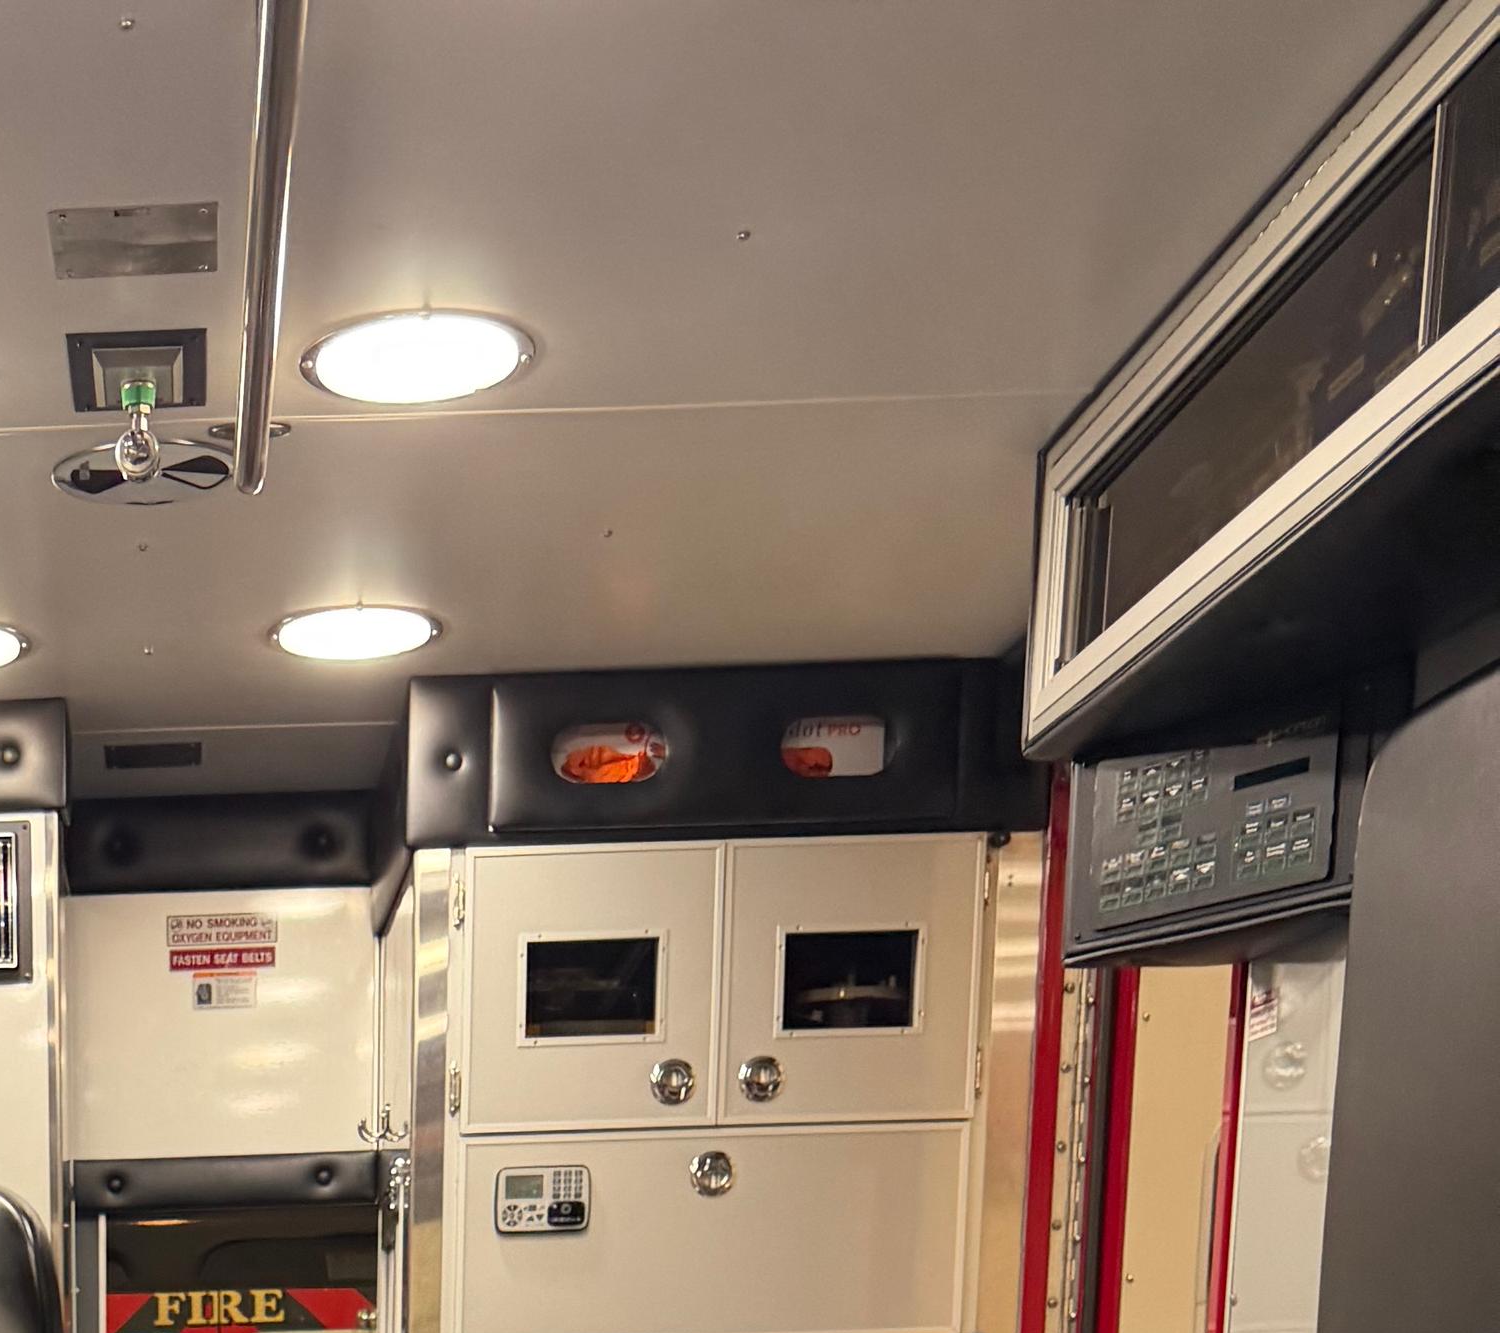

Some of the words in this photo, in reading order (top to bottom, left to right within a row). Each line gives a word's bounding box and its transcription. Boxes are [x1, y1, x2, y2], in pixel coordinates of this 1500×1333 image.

[828, 723, 861, 737] PRO
[186, 919, 203, 929] NO
[207, 917, 258, 929] SMOKING
[171, 932, 212, 943] OXYGEN
[216, 930, 272, 942] EQUIPMENT
[172, 954, 211, 966] FASTEN
[213, 952, 239, 965] SEAT
[242, 951, 273, 964] BELTS
[153, 1288, 286, 1327] FIRE
